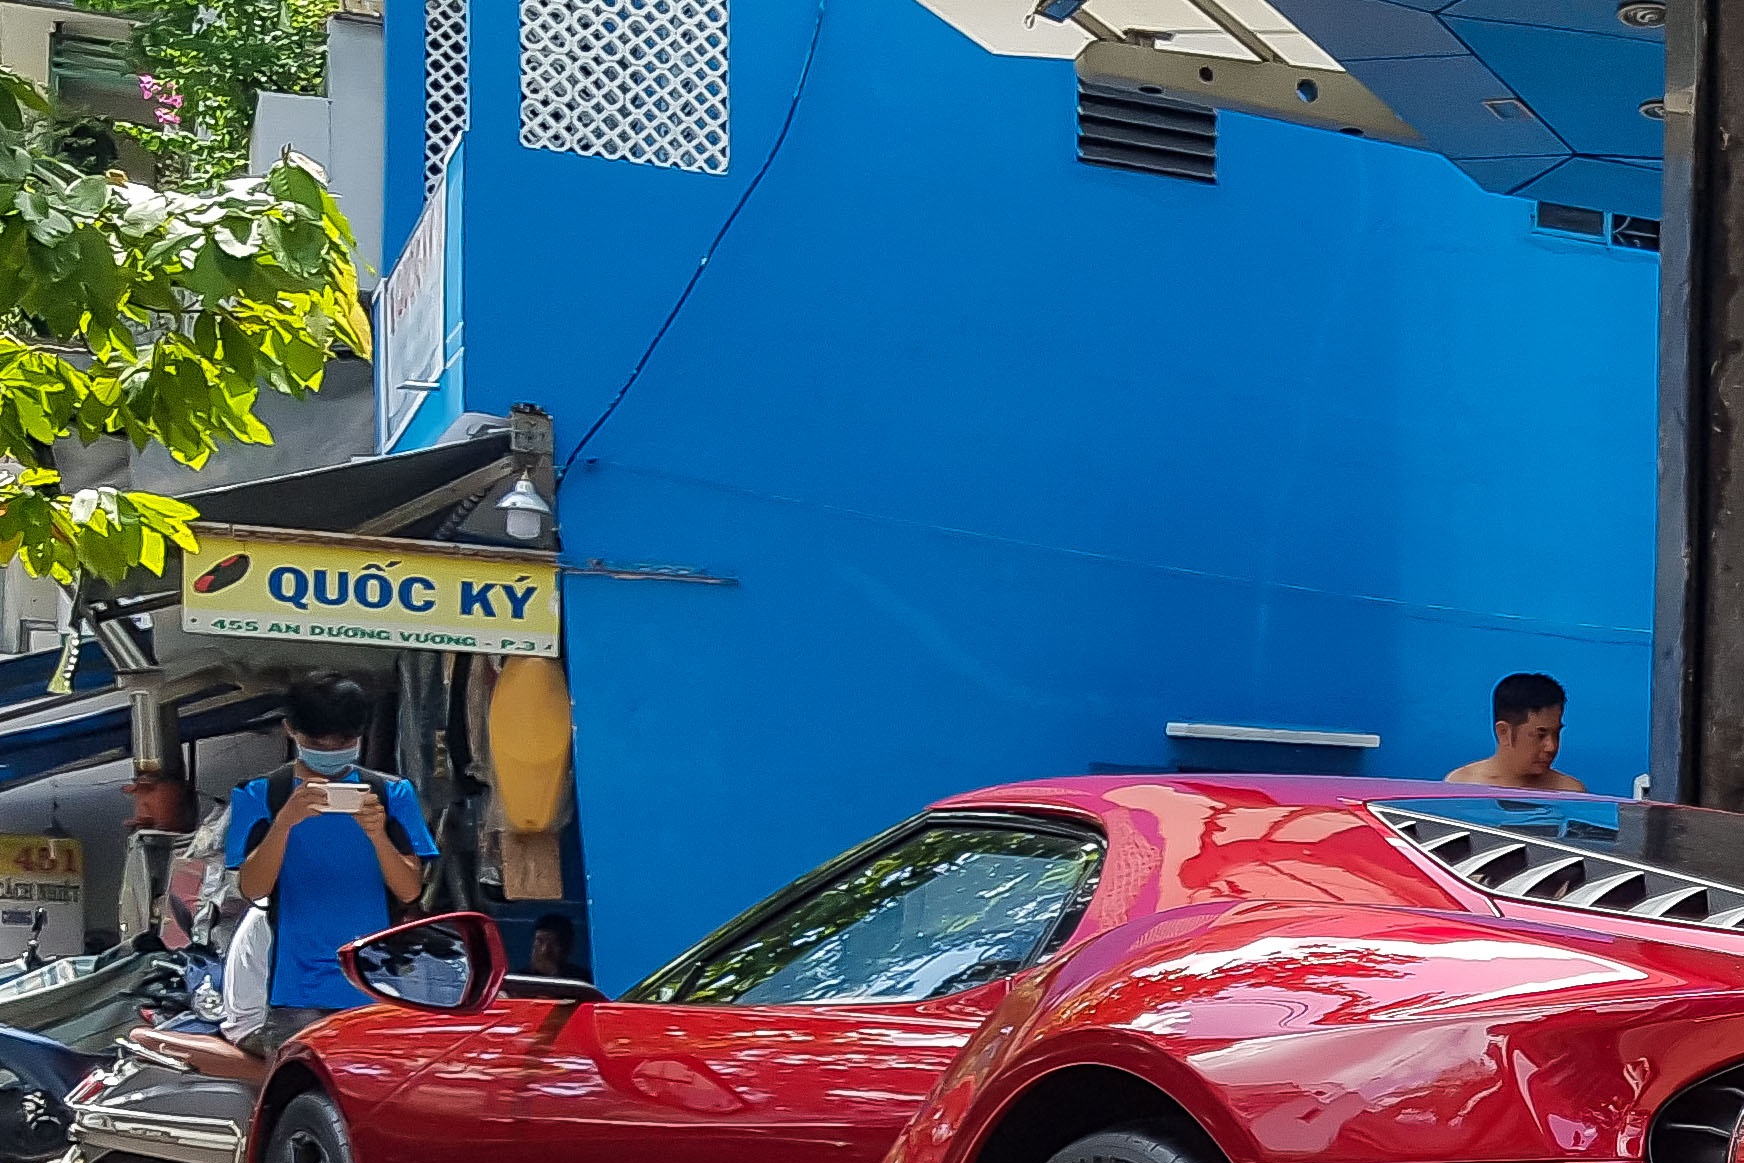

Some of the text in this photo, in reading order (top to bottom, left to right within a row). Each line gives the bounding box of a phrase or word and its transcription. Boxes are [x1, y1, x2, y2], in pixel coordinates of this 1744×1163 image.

[269, 561, 537, 619] QUỐC KÝ
[211, 619, 259, 632] 455
[268, 623, 301, 635] AN
